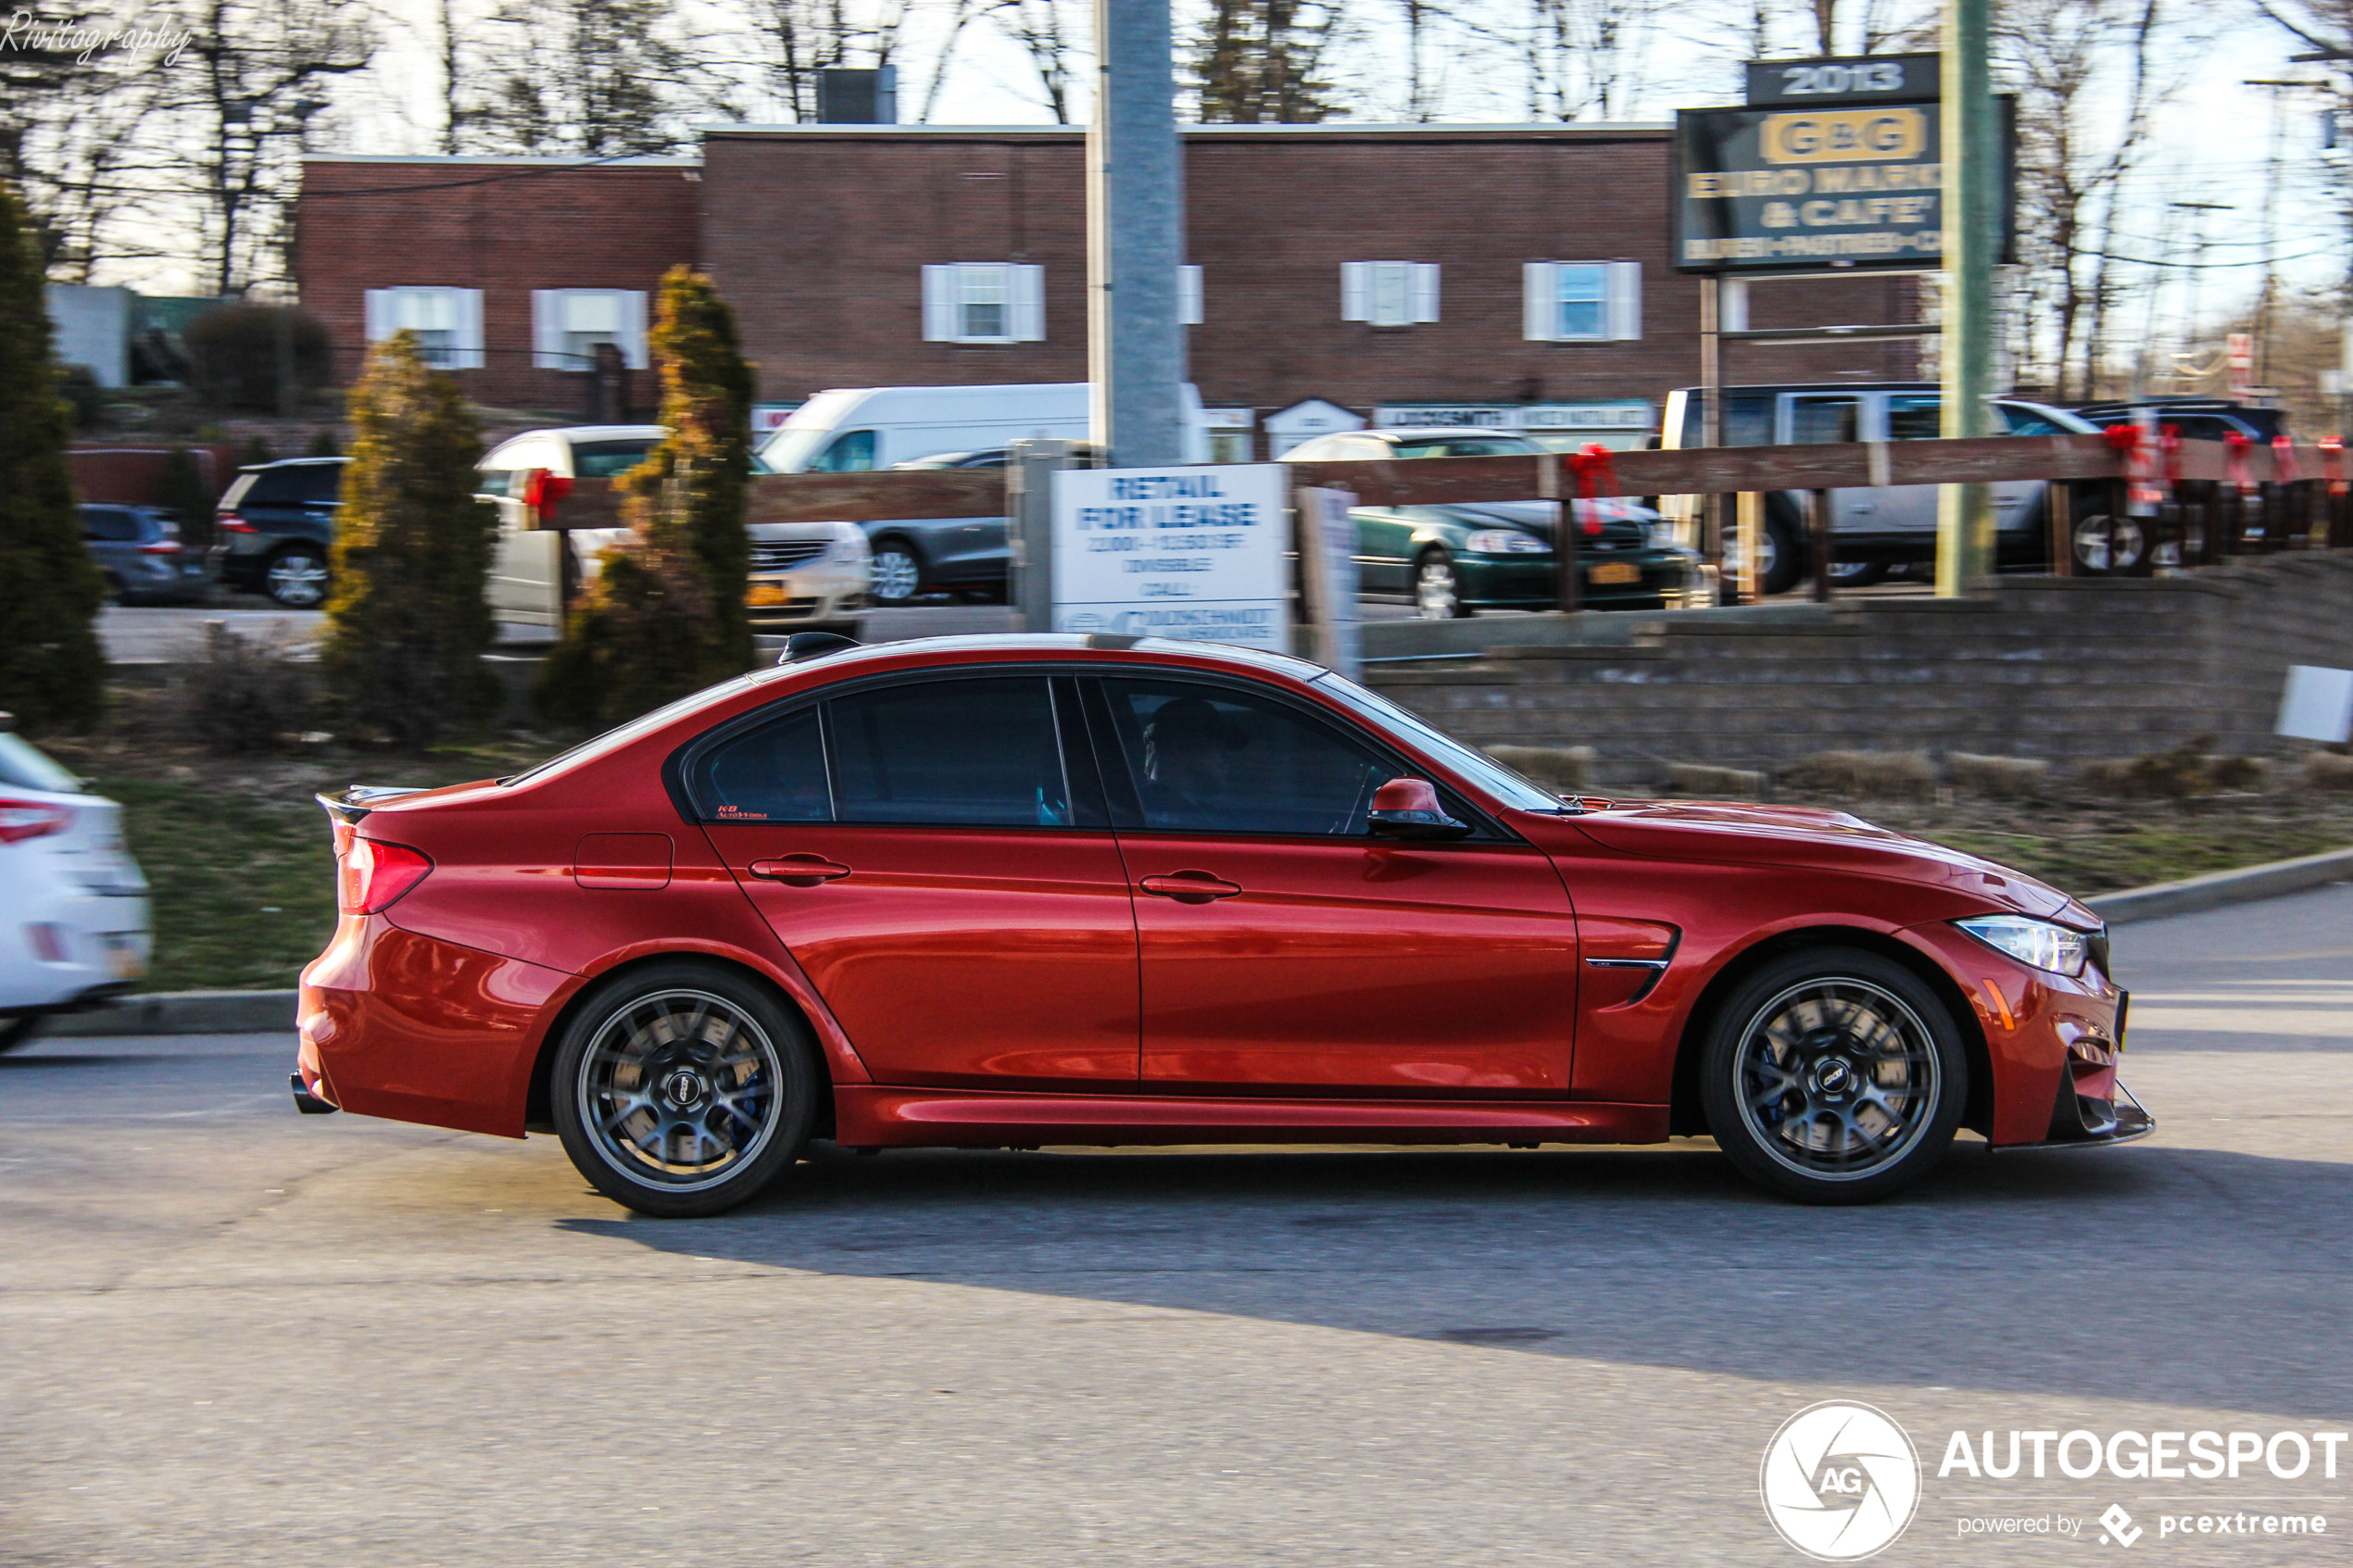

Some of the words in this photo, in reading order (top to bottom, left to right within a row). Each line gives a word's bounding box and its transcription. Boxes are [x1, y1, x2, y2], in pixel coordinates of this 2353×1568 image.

[1781, 61, 1904, 94] 2013
[1761, 201, 1798, 228] &
[1107, 475, 1227, 500] RETAIL
[1076, 506, 1147, 531] FOR
[1151, 503, 1260, 529] LEASE
